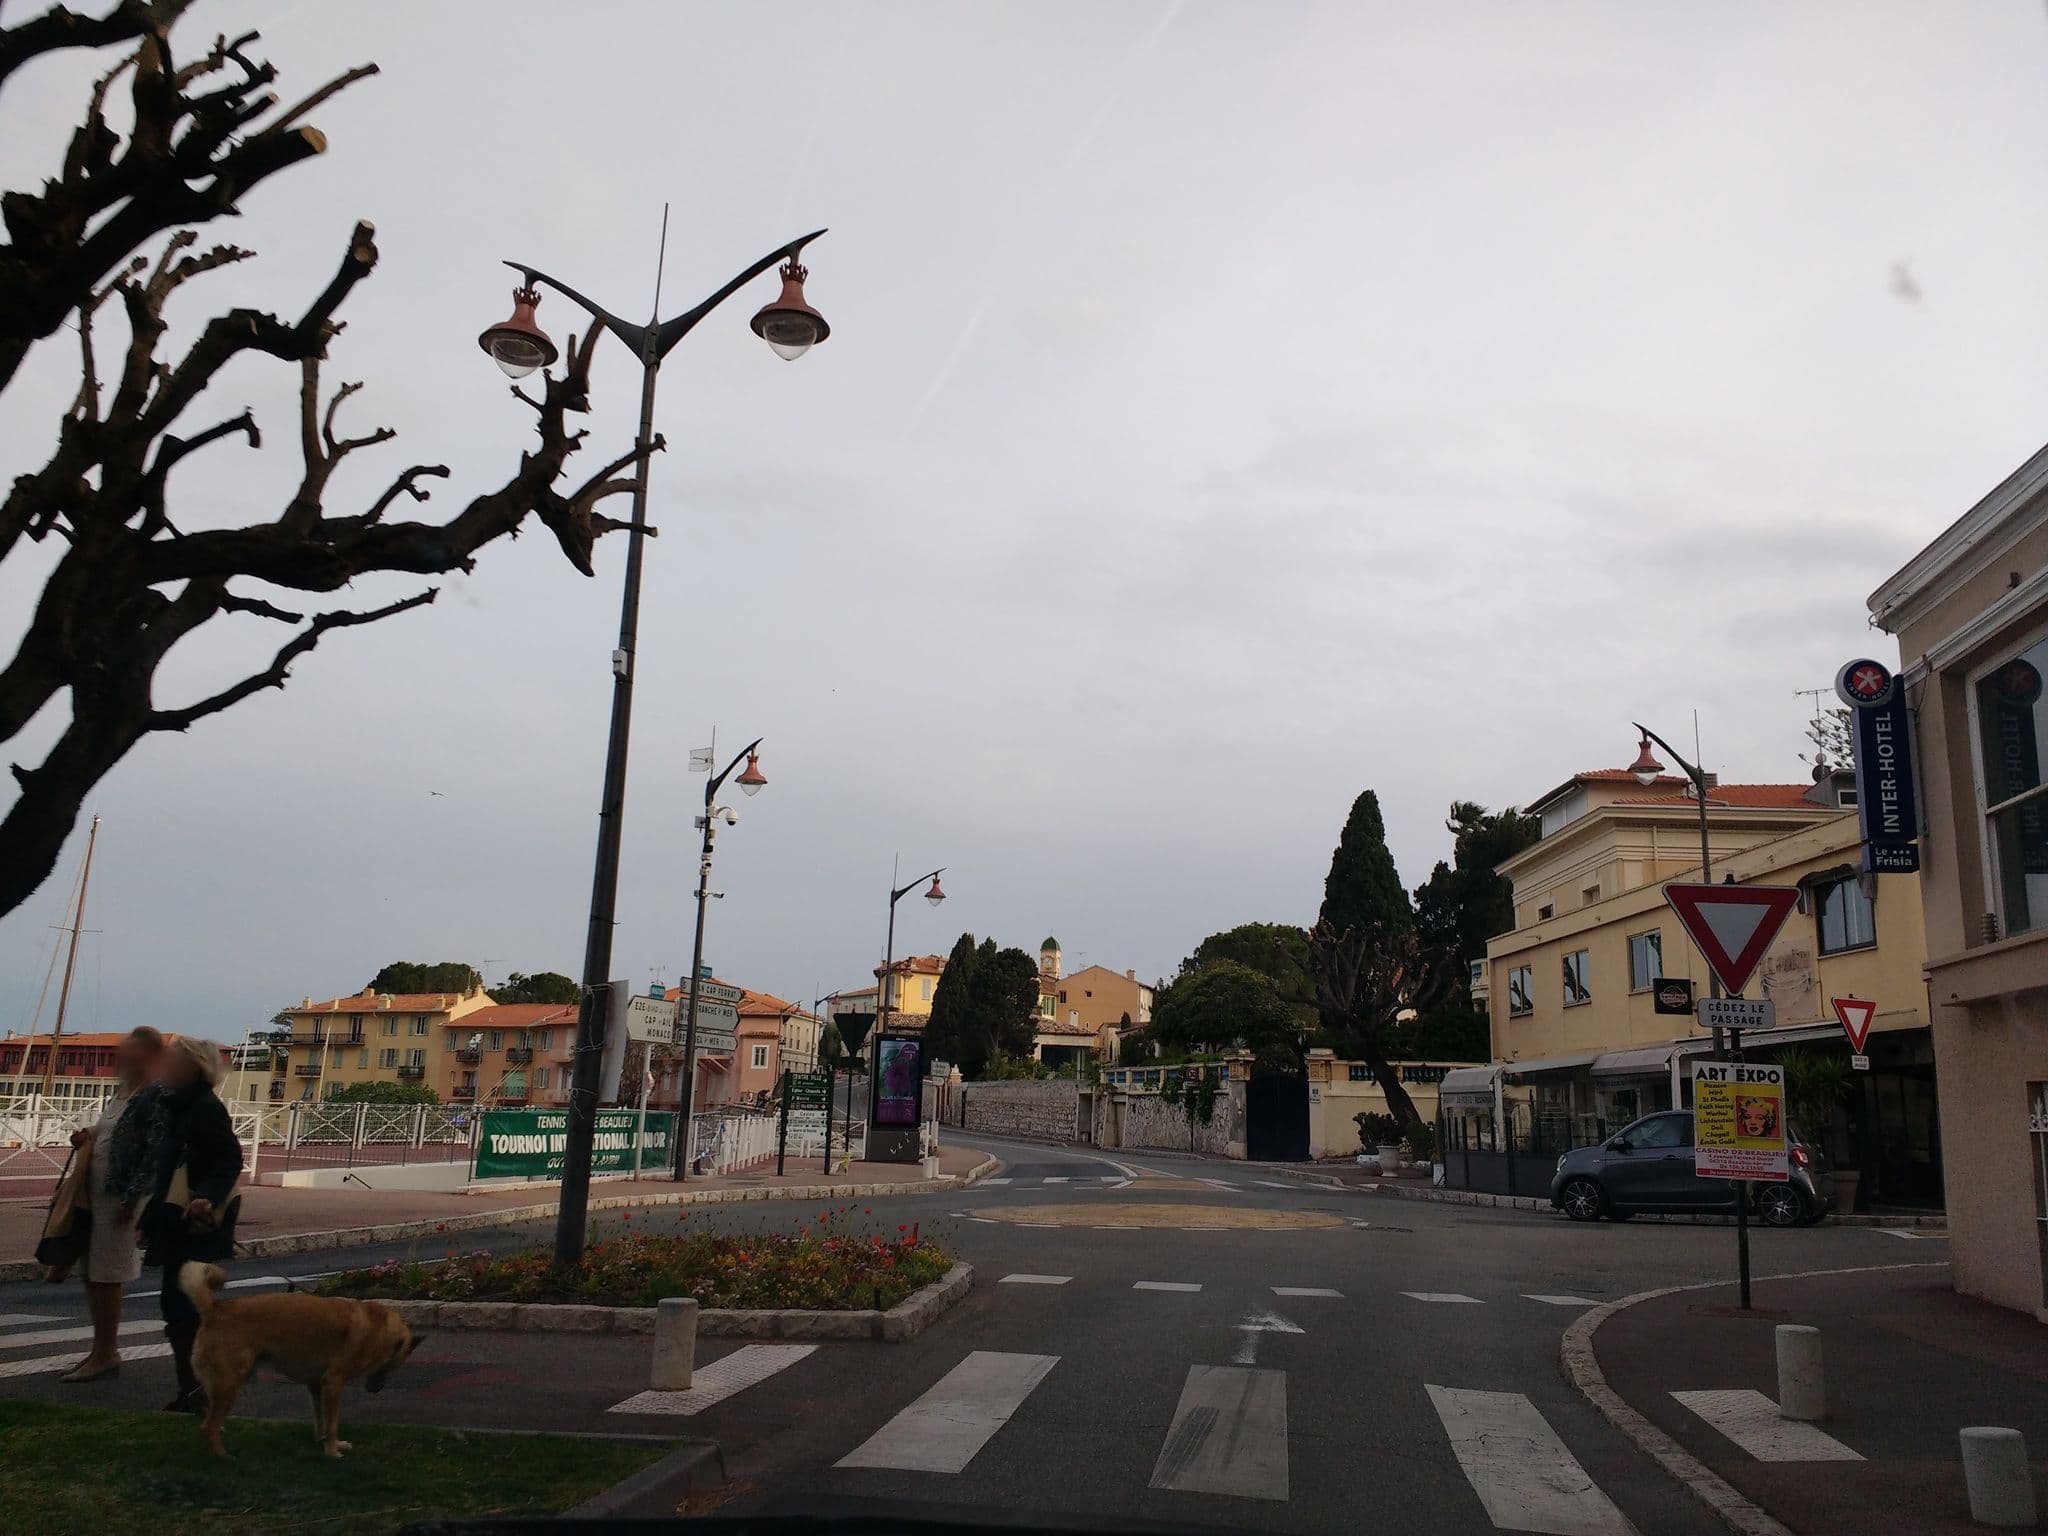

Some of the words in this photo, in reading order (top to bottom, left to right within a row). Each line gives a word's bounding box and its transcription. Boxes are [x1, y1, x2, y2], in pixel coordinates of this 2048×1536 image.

[1875, 711, 1899, 834] INTER-HOTEL
[1875, 846, 1888, 856] Le
[1876, 856, 1912, 866] Frisia
[707, 985, 717, 995] CAP
[635, 1001, 646, 1011] EZE
[1708, 1001, 1746, 1013] CÉDEZ
[1751, 1004, 1765, 1013] LE
[1711, 1014, 1763, 1025] PASSAGE
[646, 1028, 671, 1039] MONACO
[1696, 1067, 1727, 1081] ART
[1736, 1069, 1780, 1084] EXPO
[537, 1116, 567, 1129] TENNIS
[600, 1116, 634, 1128] BEAULIEU
[1705, 1131, 1730, 1139] Chagall
[490, 1134, 548, 1155] TOURNOI
[550, 1132, 630, 1153] INTTIONAL
[632, 1131, 666, 1150] JNIOR
